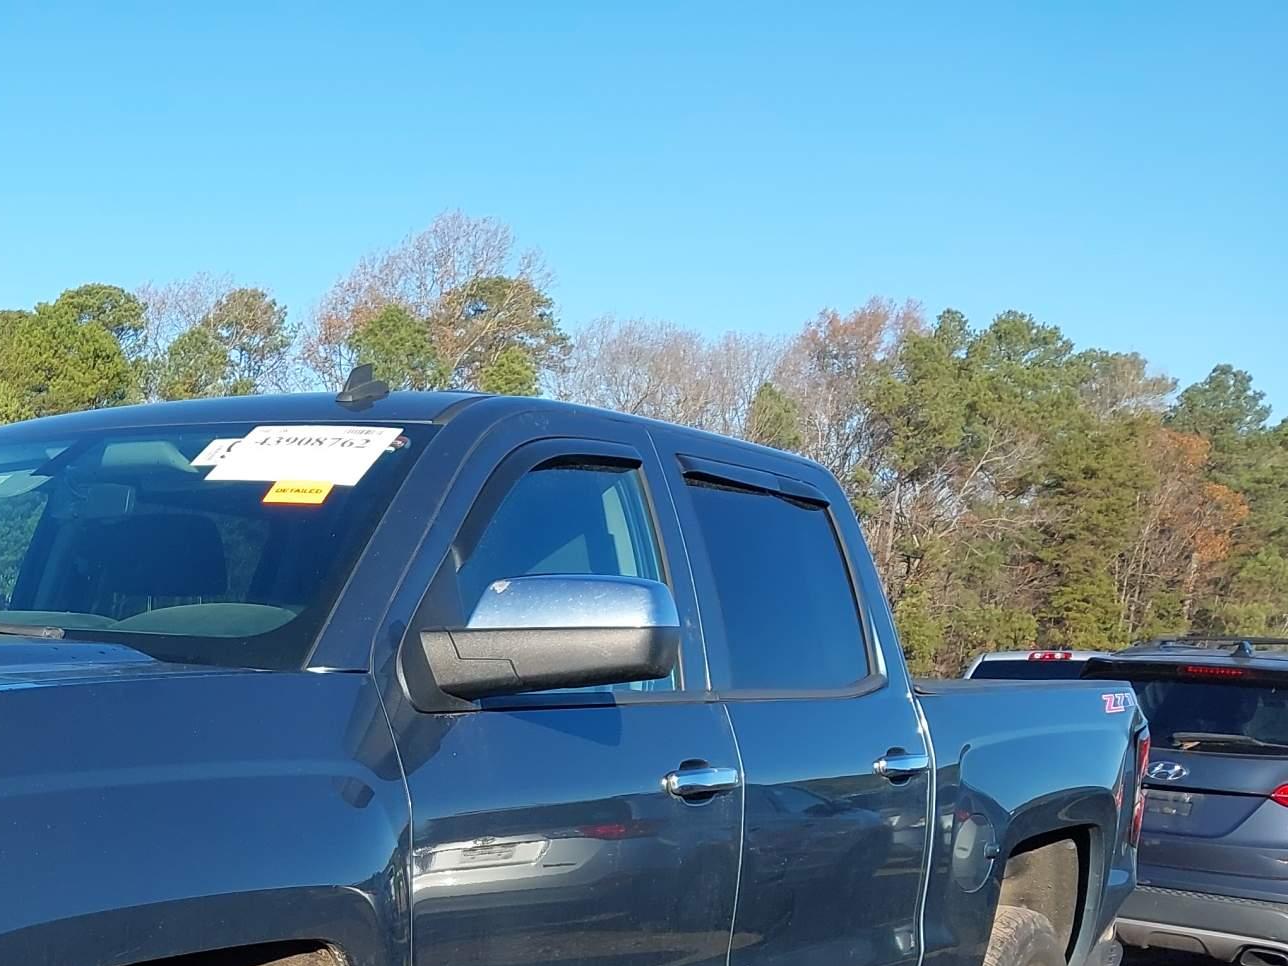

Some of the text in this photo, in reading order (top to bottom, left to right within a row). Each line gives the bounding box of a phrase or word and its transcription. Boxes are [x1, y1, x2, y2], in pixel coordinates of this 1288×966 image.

[255, 436, 372, 449] 43908762
[274, 486, 324, 495] DETAILED
[1102, 692, 1135, 713] Z71
